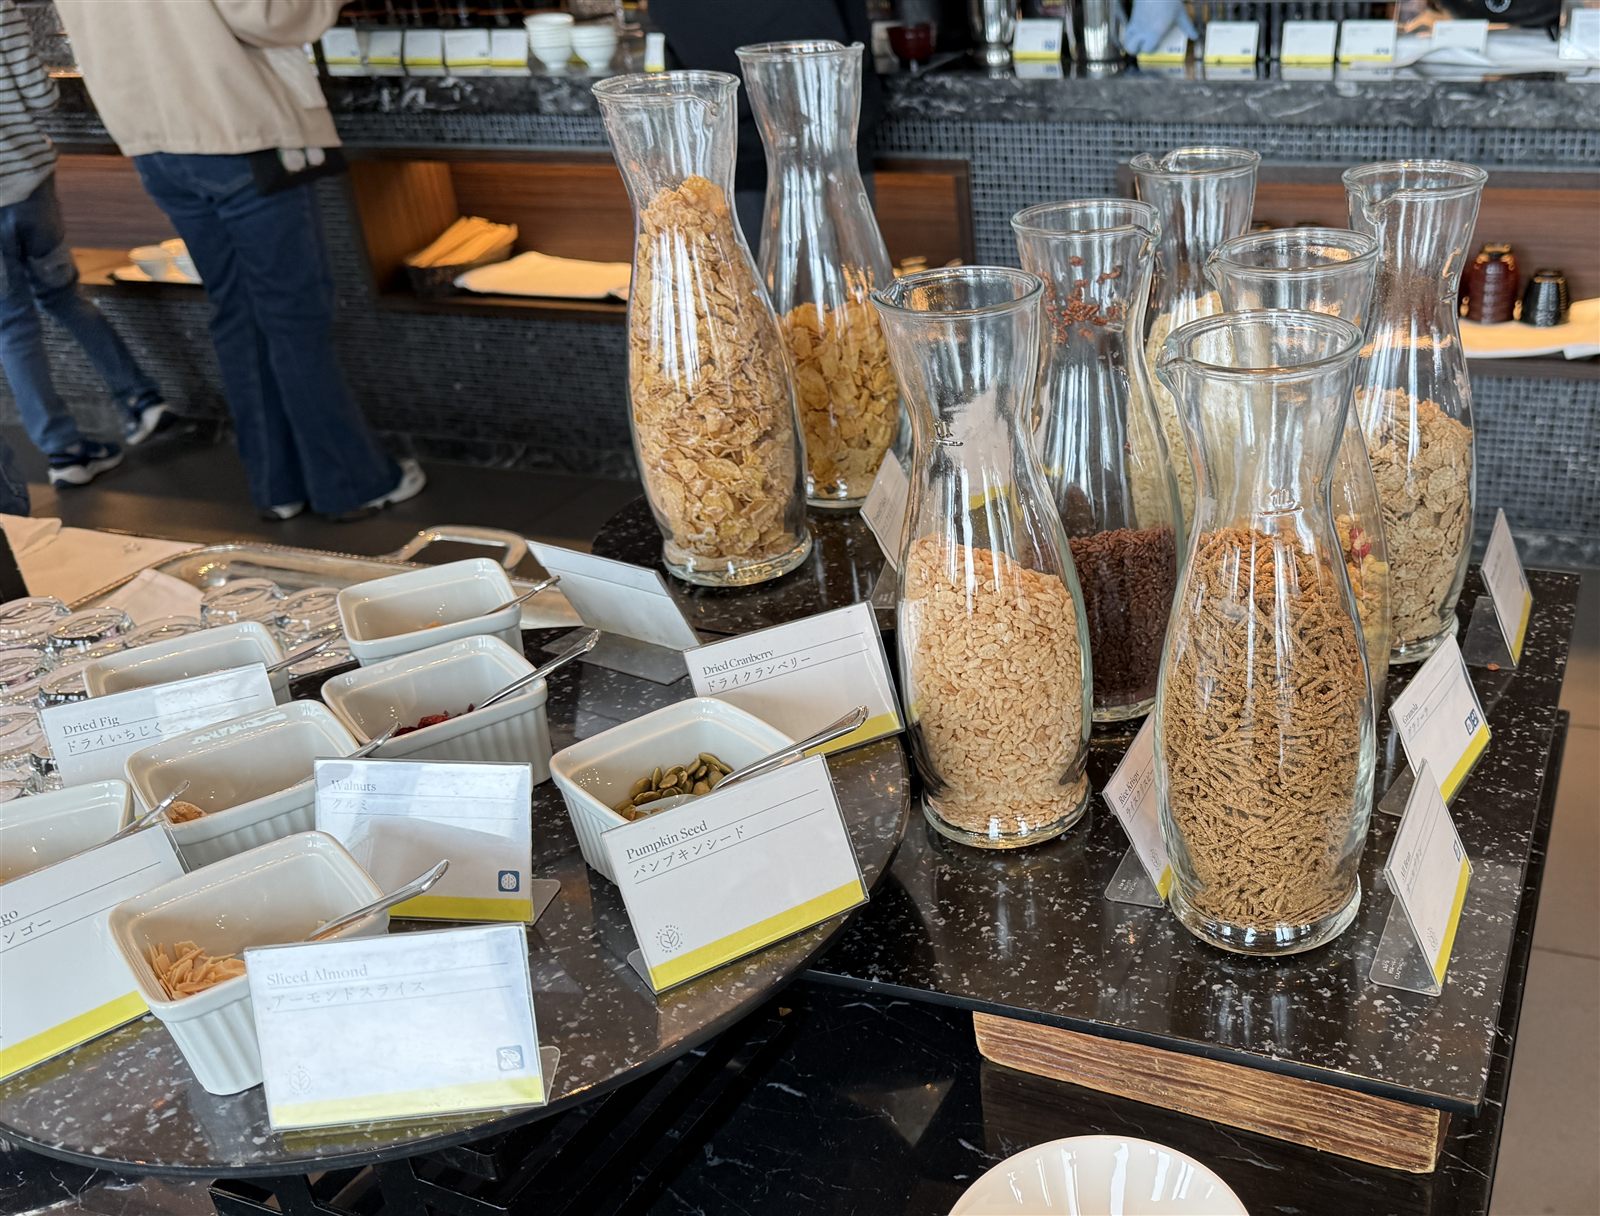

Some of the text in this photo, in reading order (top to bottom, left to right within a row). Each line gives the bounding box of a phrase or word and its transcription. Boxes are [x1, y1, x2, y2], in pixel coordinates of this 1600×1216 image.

[702, 649, 774, 676] Dried Cranberry
[707, 657, 811, 693] ドライクランベリー
[63, 716, 120, 736] Dried Fig
[67, 722, 162, 753] ドライいちじく
[331, 779, 377, 792] Walnuts
[331, 798, 368, 811] クルミ
[625, 819, 708, 860] Pumpkin Seed
[633, 824, 745, 879] パンプキンシード
[0, 910, 18, 927] go
[267, 963, 369, 986] Sliced Almond
[271, 981, 426, 1009] アーモンドスライス
